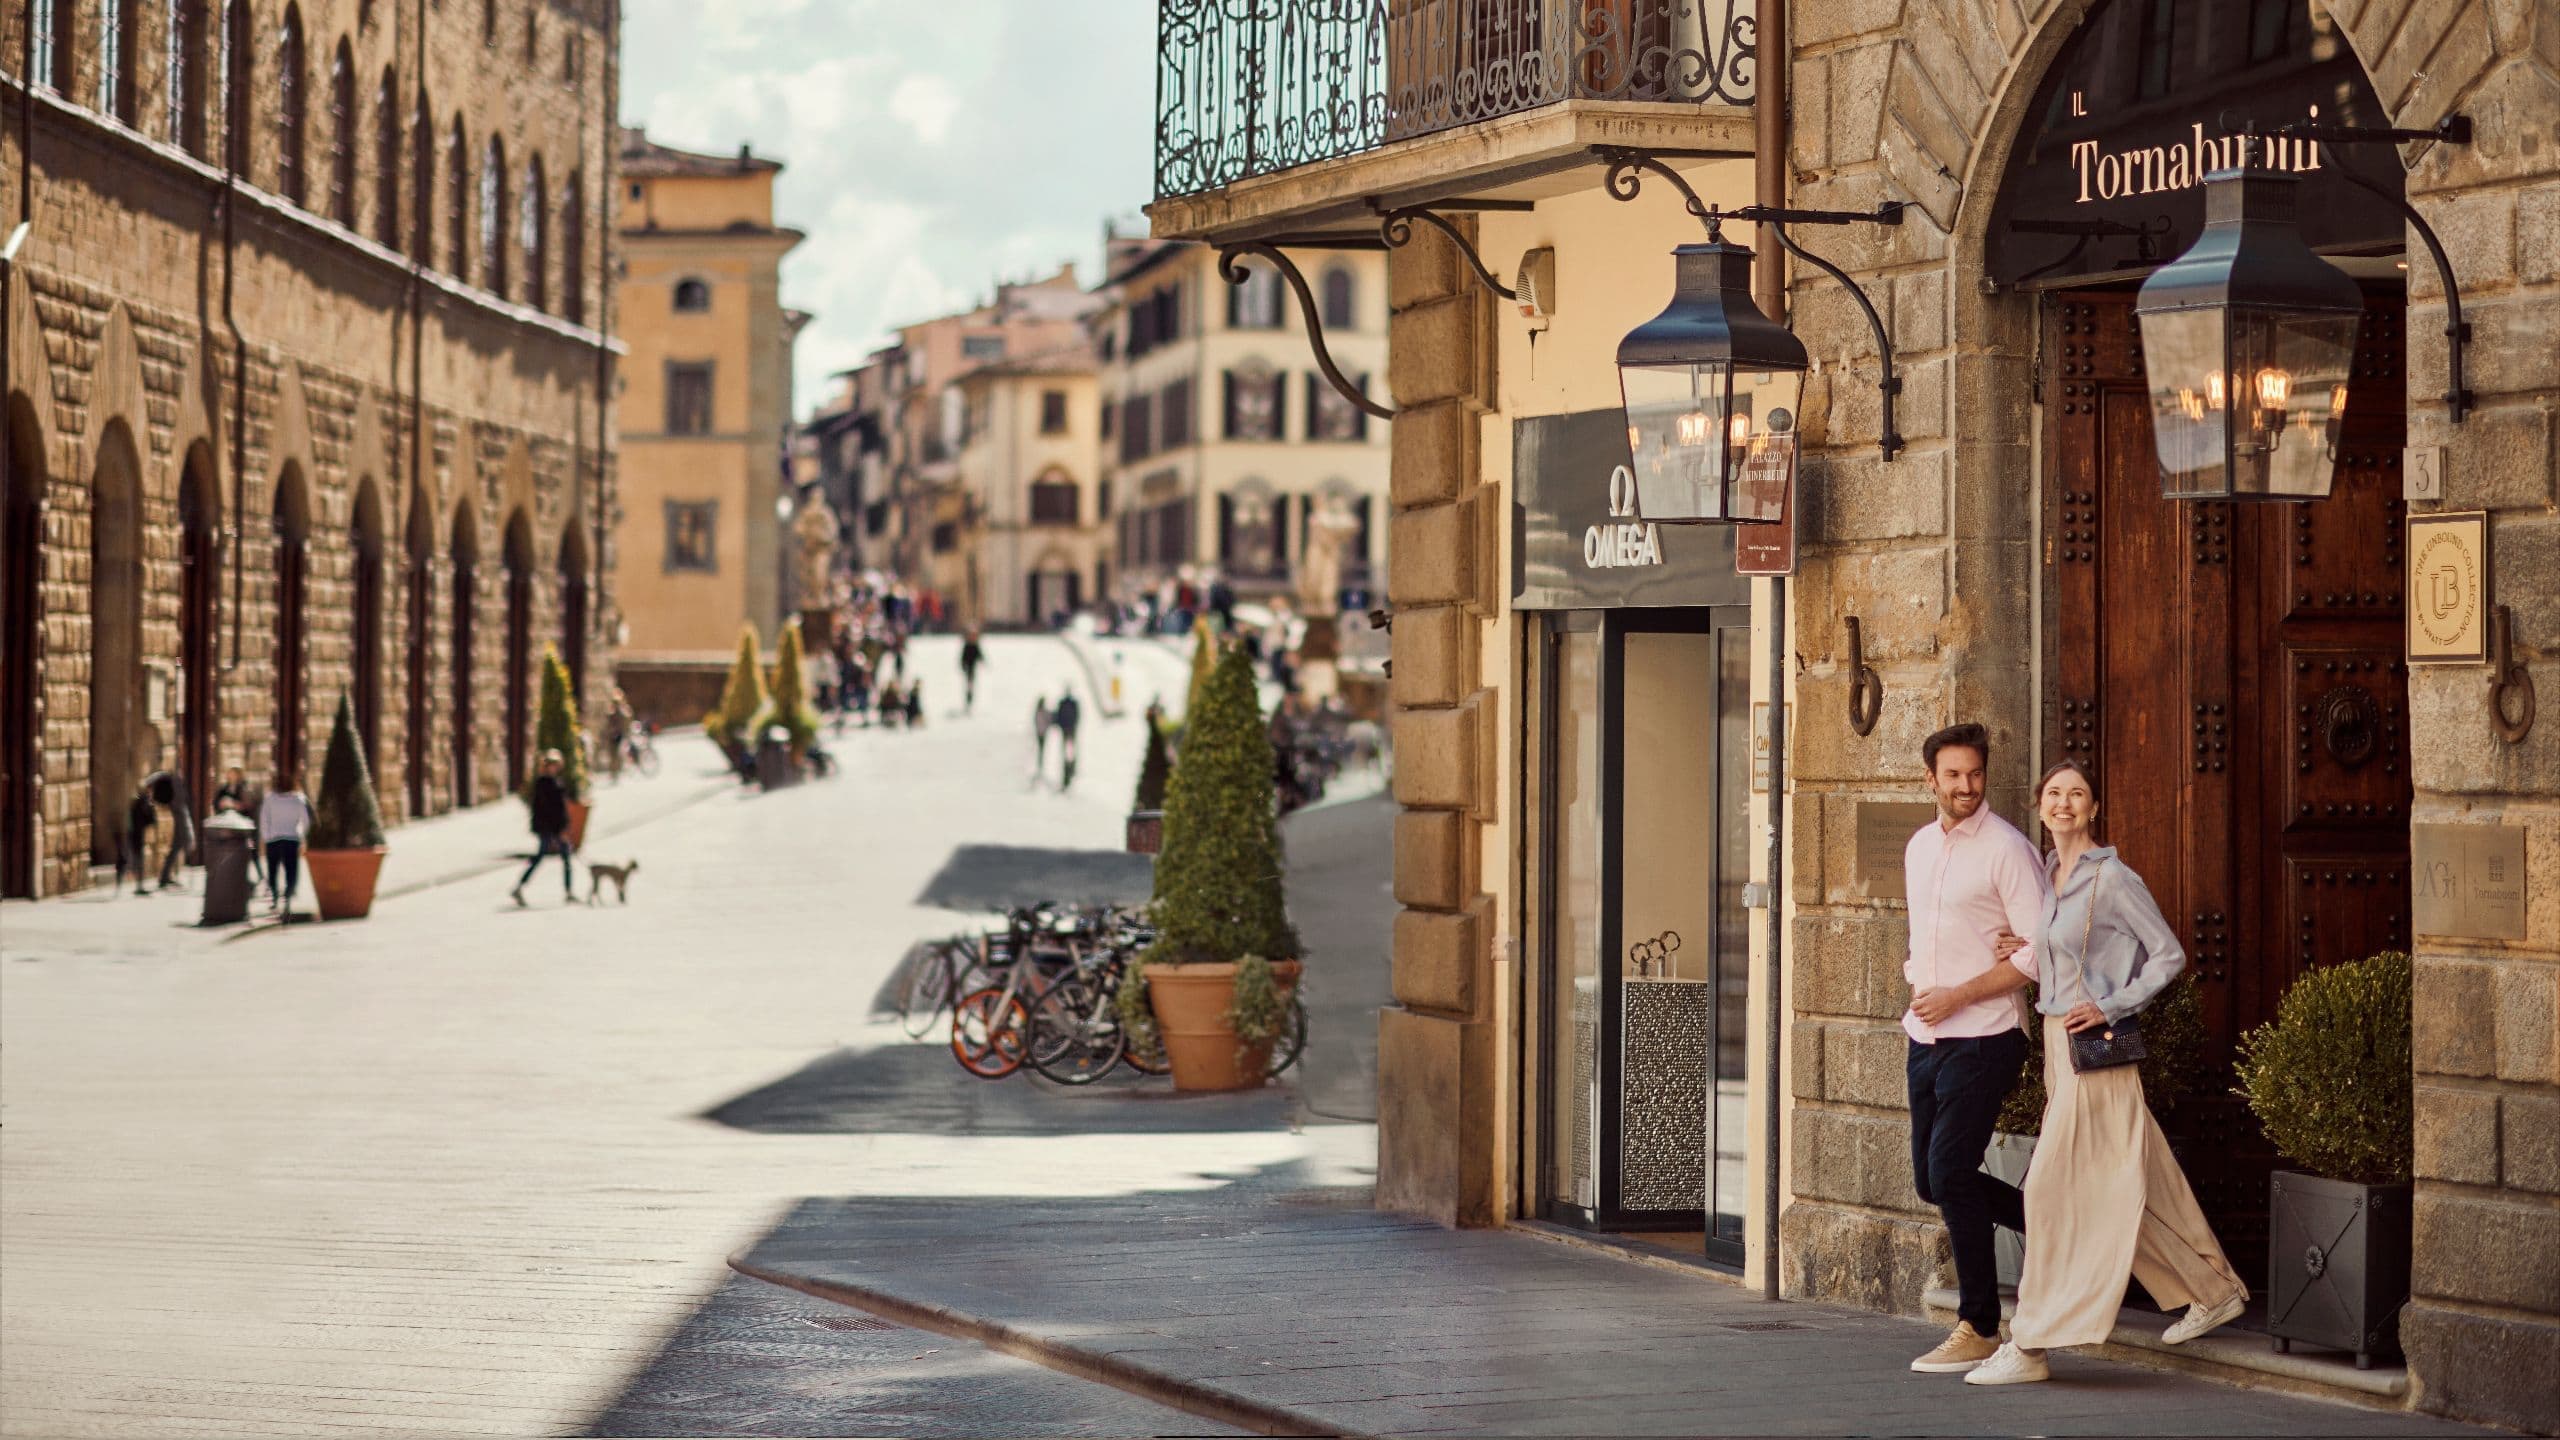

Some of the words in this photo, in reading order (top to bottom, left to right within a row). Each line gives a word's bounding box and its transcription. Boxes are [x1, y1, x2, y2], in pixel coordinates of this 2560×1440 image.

[2072, 91, 2087, 117] IL
[1751, 451, 1782, 463] PALAZZO
[2415, 453, 2430, 492] 3
[1584, 523, 1663, 569] OMEGA
[2415, 549, 2428, 576] THE
[2426, 531, 2463, 551] UNBOUND
[2459, 548, 2477, 636] COLLECTION
